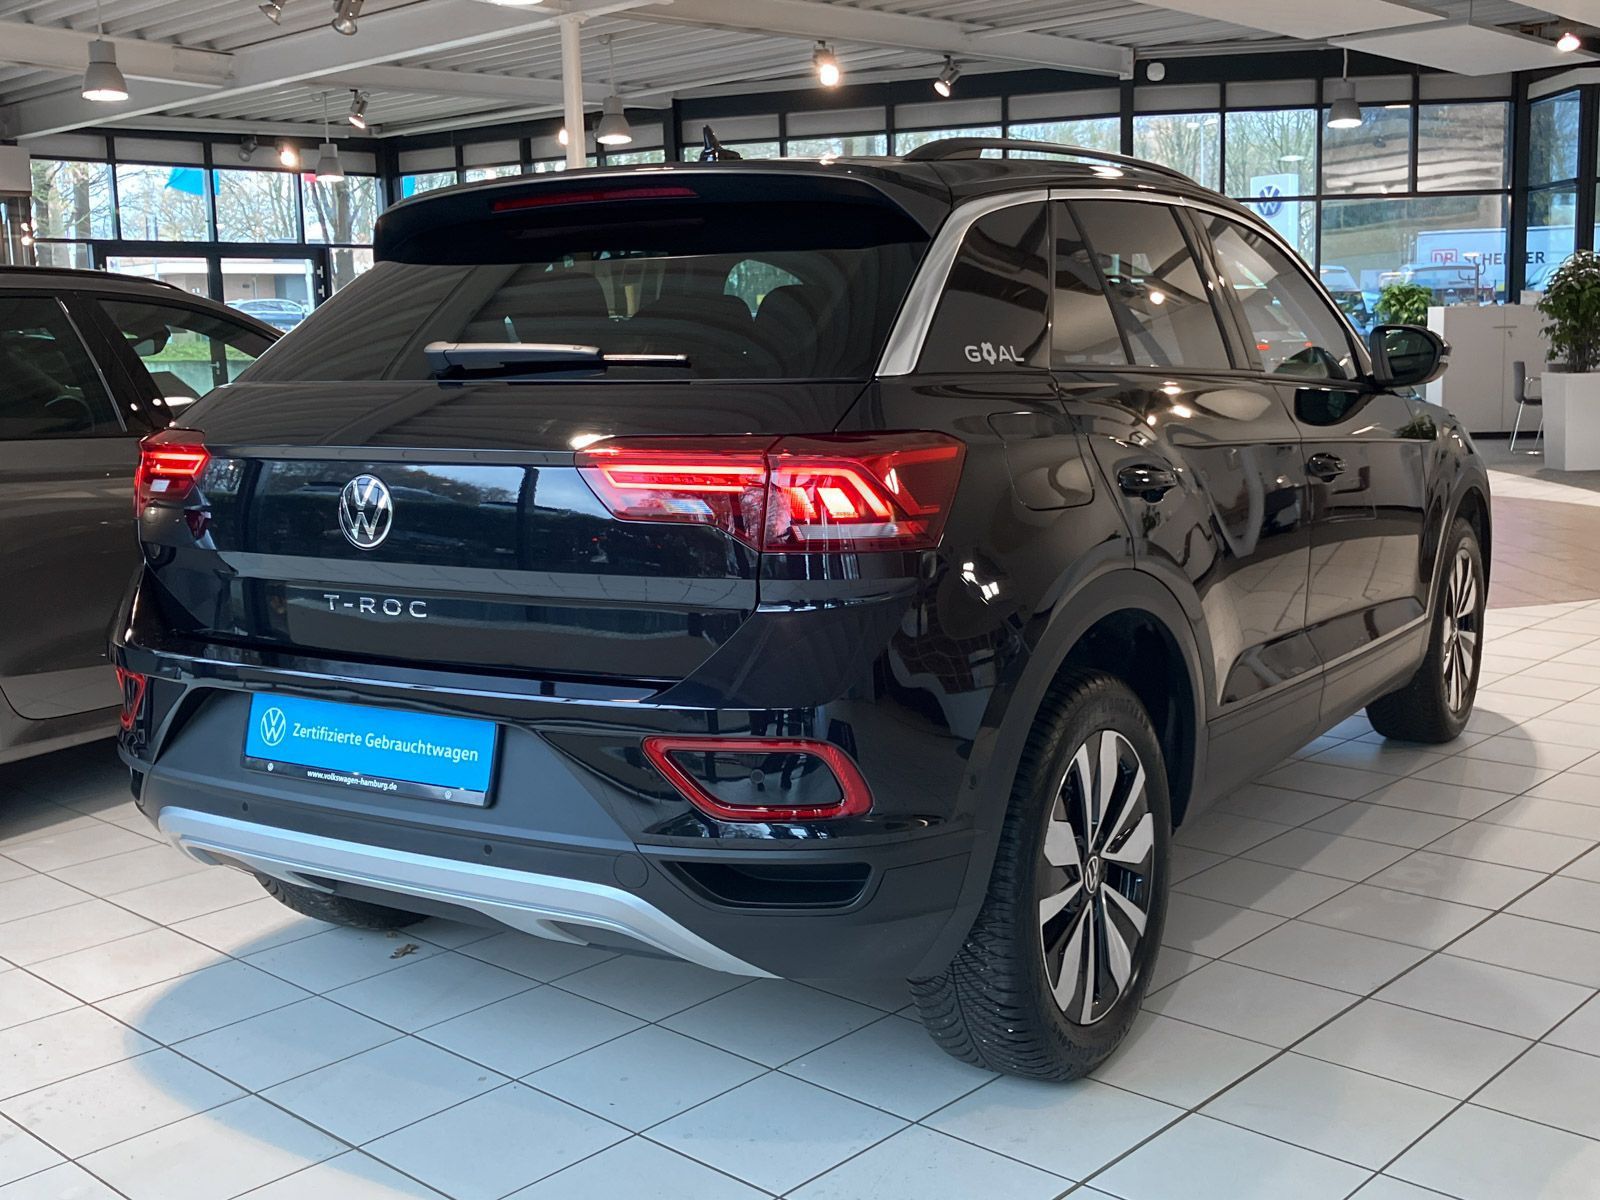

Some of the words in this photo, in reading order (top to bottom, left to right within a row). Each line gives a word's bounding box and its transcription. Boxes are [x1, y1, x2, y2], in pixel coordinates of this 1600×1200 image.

[339, 474, 393, 550] VW
[323, 594, 427, 618] T-ROC
[260, 707, 286, 746] VW
[292, 722, 362, 746] Zertifizierte
[365, 732, 479, 763] Gebrauchtwagen
[307, 770, 398, 791] www.volkswagen-hamburg.de
